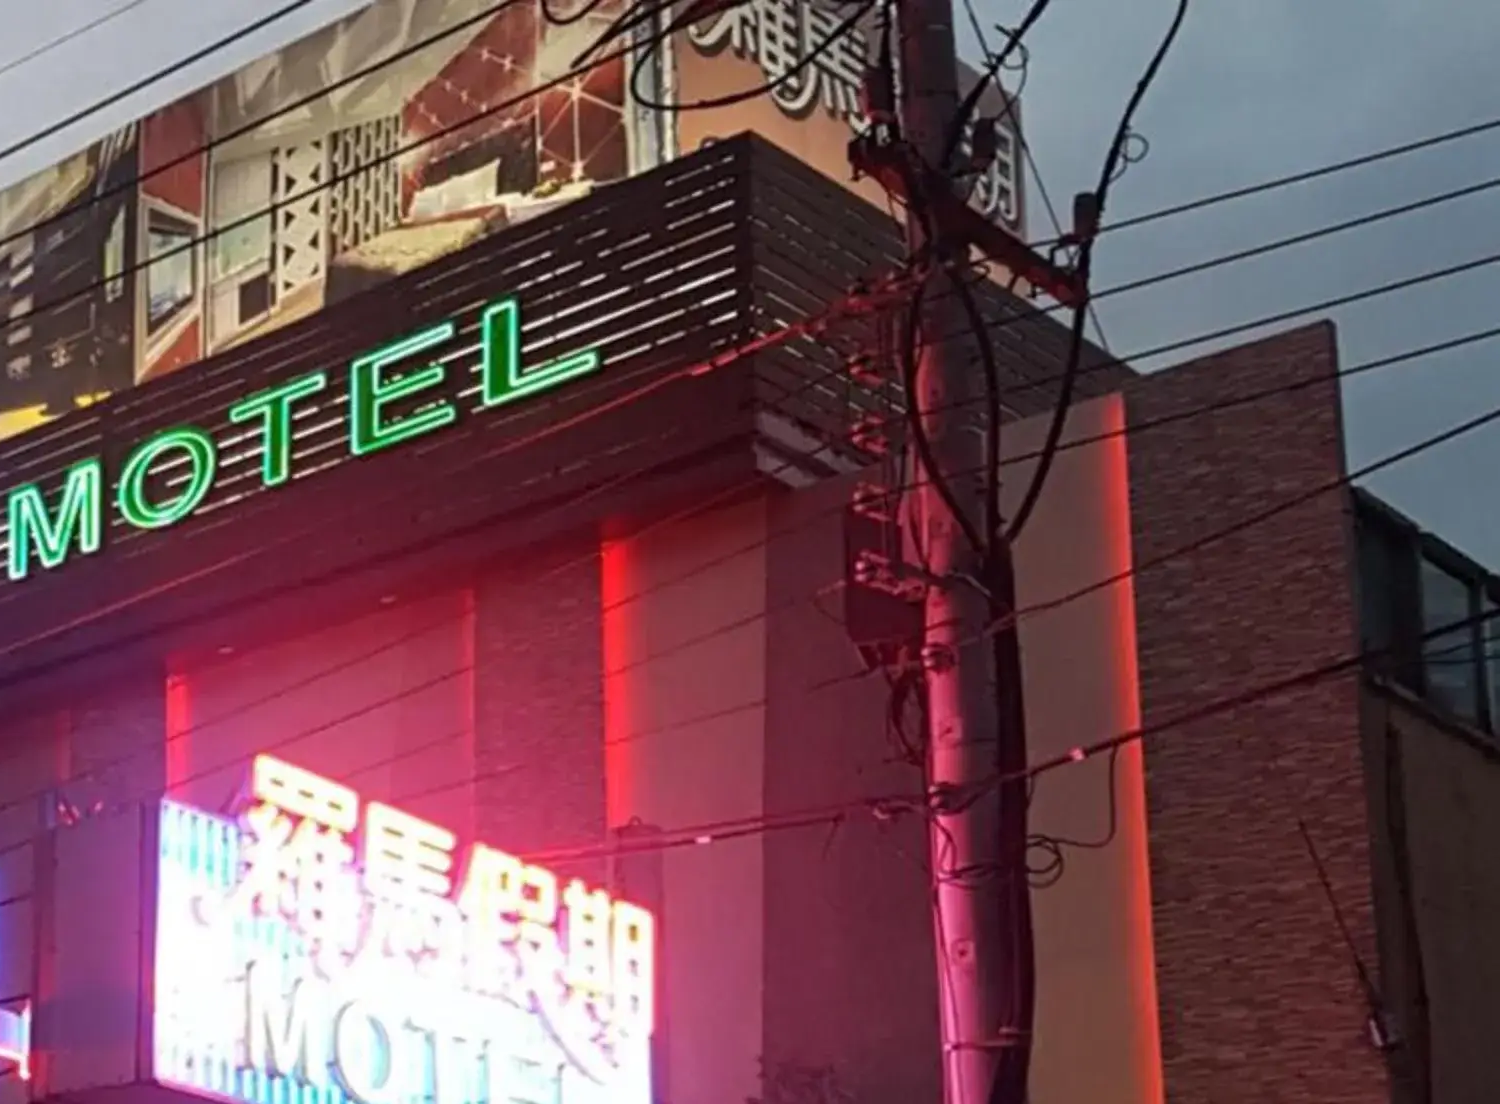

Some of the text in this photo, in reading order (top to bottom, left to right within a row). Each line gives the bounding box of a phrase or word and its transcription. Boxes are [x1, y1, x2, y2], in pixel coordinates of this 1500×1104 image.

[6, 298, 600, 582] MOTEL
[230, 753, 656, 1085] 羅馬假期
